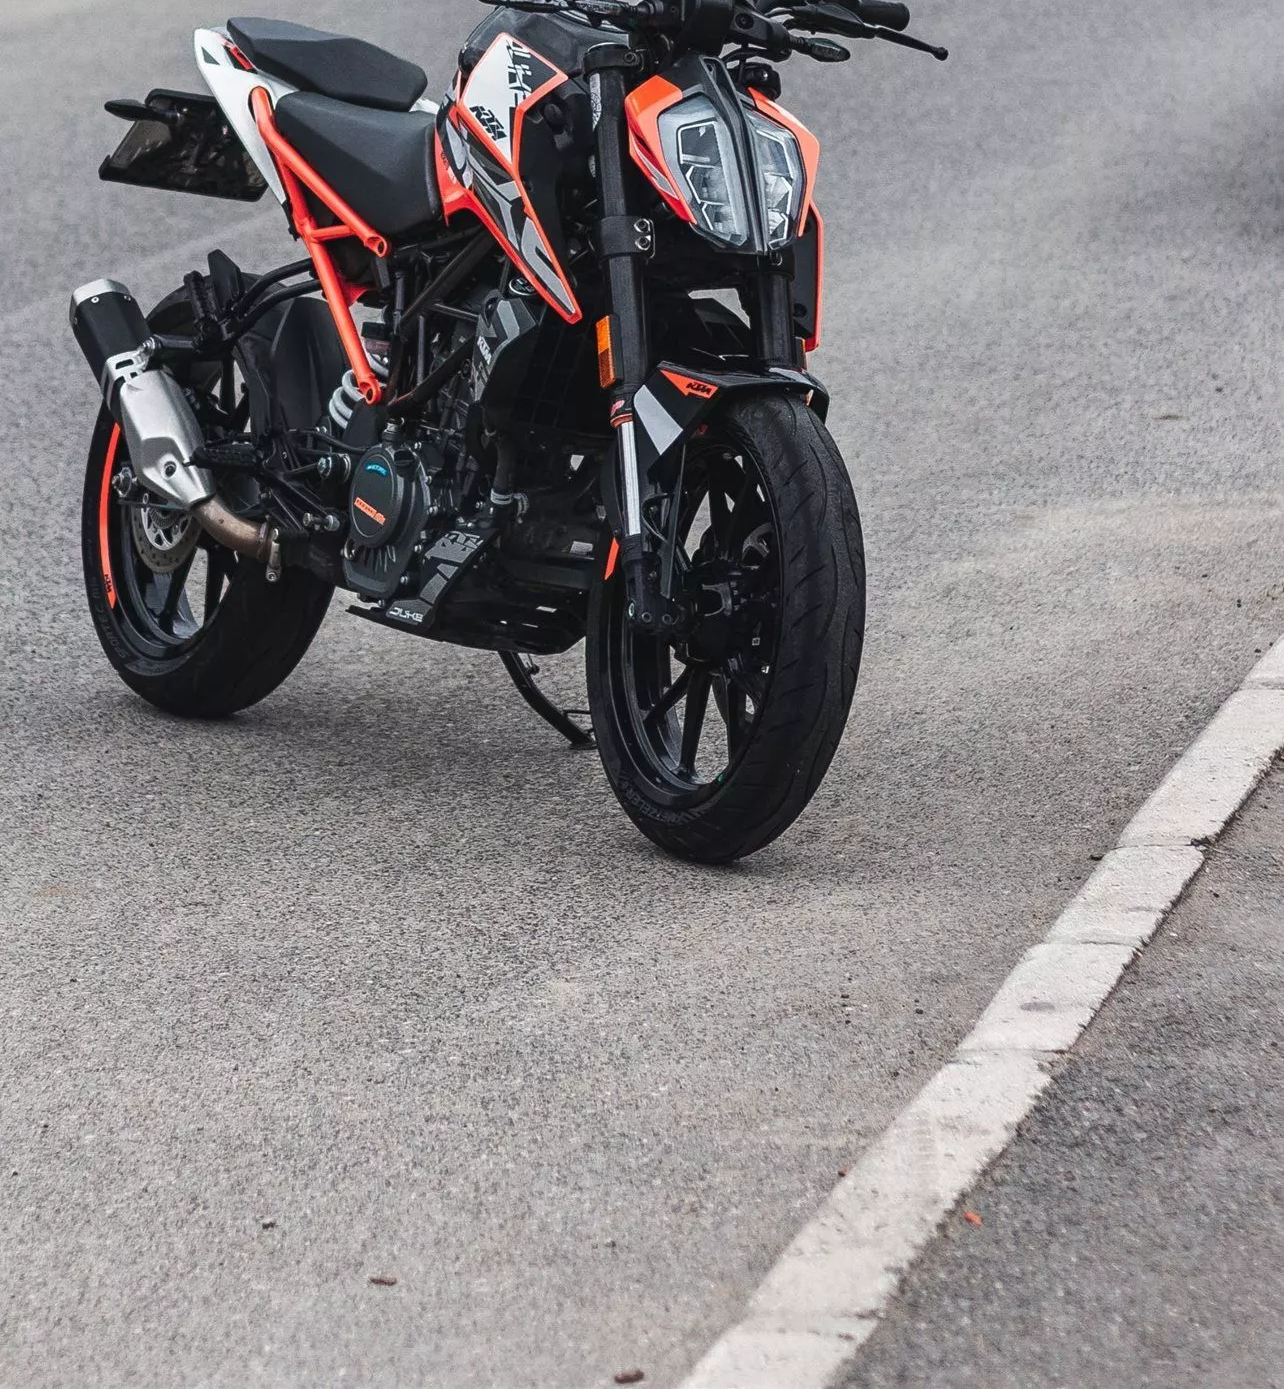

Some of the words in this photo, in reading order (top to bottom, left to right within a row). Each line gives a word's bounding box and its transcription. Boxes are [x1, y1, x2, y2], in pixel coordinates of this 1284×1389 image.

[469, 106, 507, 141] KTM
[476, 336, 492, 365] KTM
[686, 382, 712, 395] KTM
[389, 607, 424, 623] DUKE
